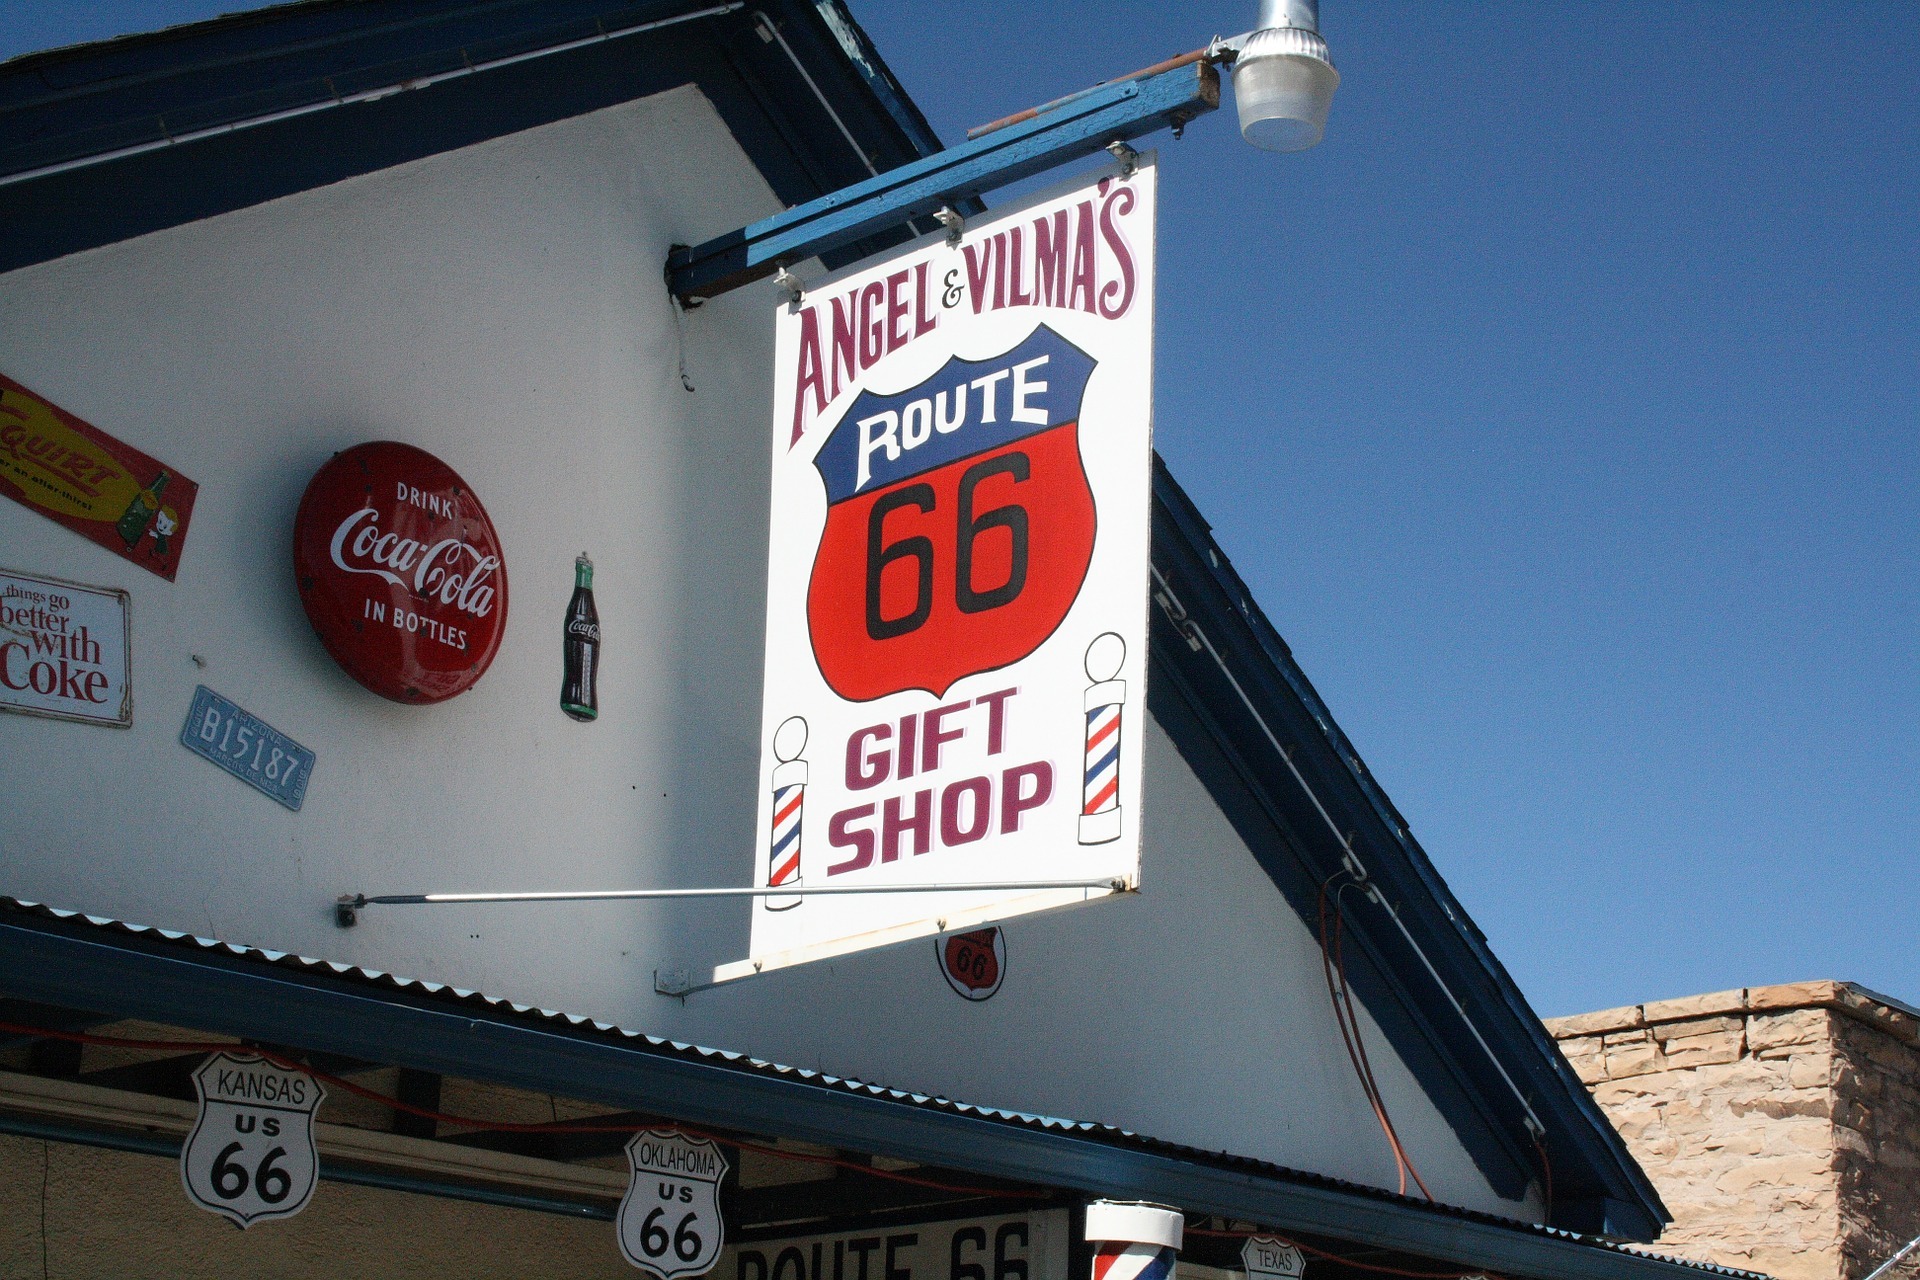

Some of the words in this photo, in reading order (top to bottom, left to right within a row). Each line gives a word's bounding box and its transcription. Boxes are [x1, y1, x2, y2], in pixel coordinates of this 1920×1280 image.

[786, 259, 940, 455] ANGEL
[942, 269, 965, 309] &
[960, 174, 1140, 321] VILMA'S
[855, 354, 1050, 492] ROUTE
[397, 481, 452, 520] DRINK
[330, 508, 500, 617] Coca-Cola
[864, 450, 1031, 641] 66
[0, 597, 70, 633] better
[49, 593, 70, 612] go
[364, 598, 385, 623] IN
[393, 607, 467, 650] BOTTLES
[28, 625, 102, 665] with
[0, 641, 109, 704] Coke
[200, 706, 299, 787] B15187
[231, 709, 282, 746] ARIZONA
[844, 686, 1021, 791] GIFT
[826, 759, 1054, 877] SHOP
[957, 945, 988, 980] 66
[217, 1069, 306, 1105] KANSAS
[235, 1114, 280, 1137] US
[211, 1141, 292, 1204] 66
[640, 1142, 716, 1177] OKLAHOMA
[659, 1182, 693, 1203] US
[640, 1206, 703, 1263] 66
[951, 1222, 1029, 1280] 66
[1257, 1249, 1292, 1271] TEXAS
